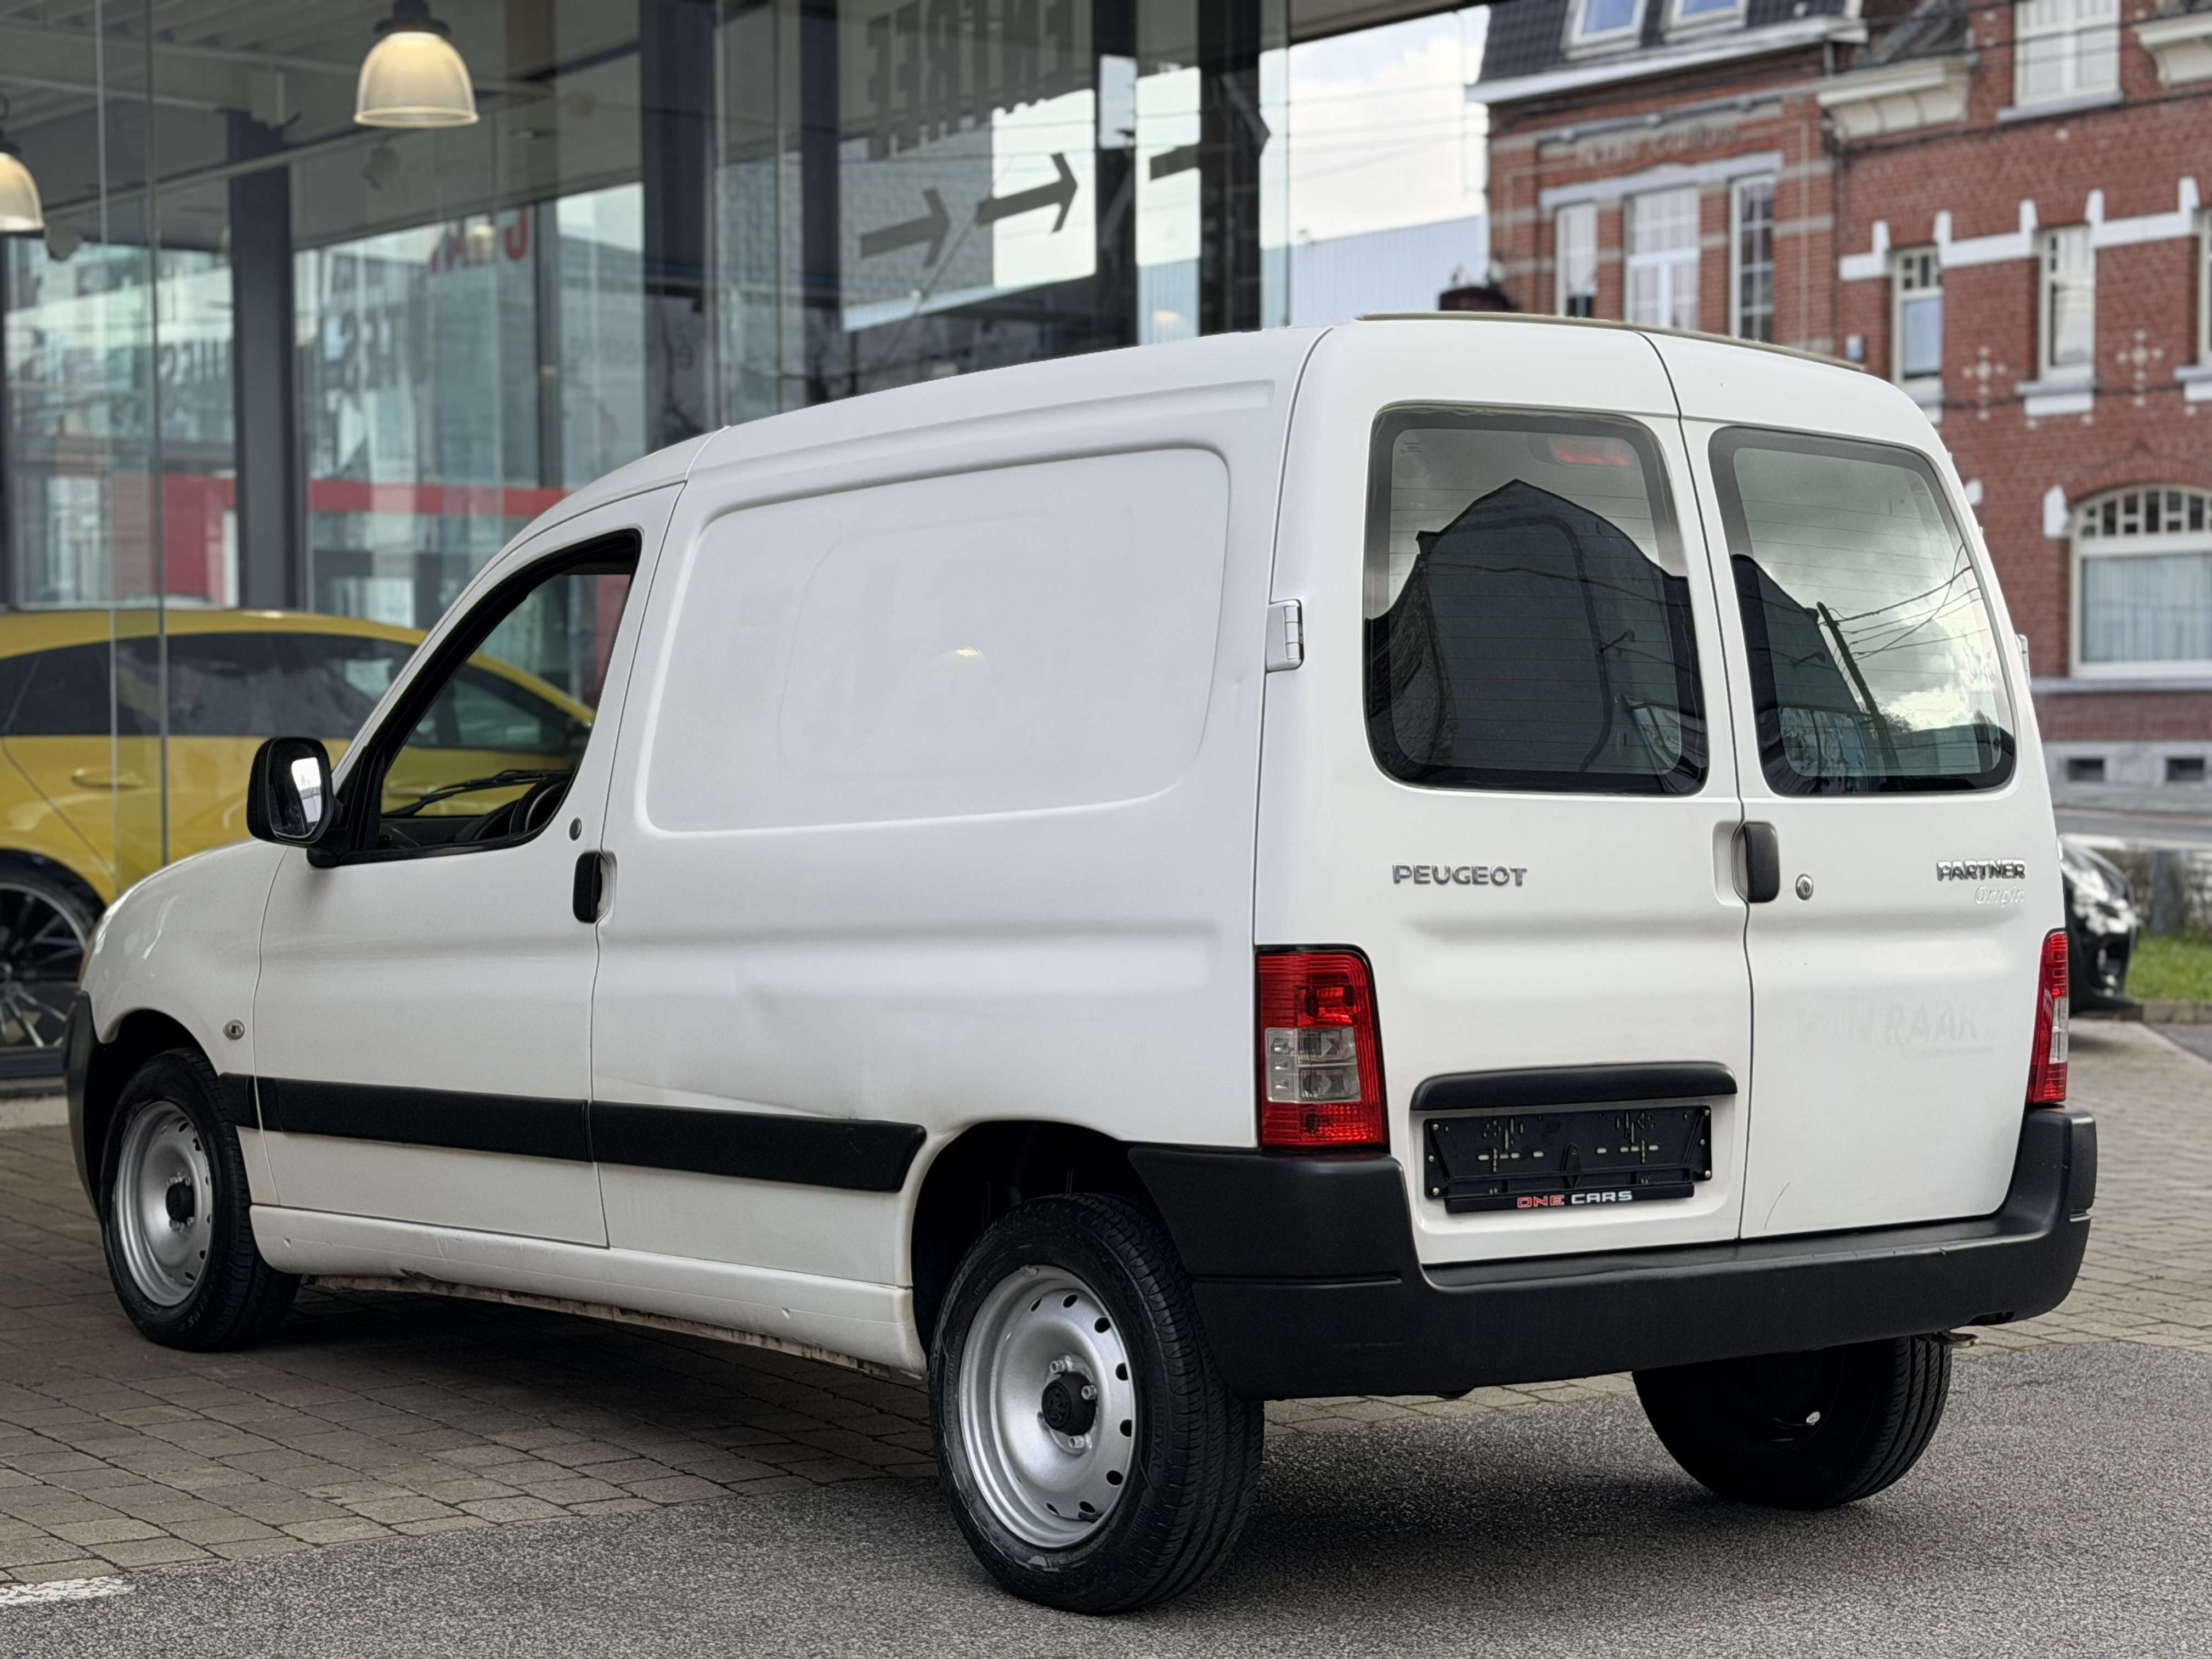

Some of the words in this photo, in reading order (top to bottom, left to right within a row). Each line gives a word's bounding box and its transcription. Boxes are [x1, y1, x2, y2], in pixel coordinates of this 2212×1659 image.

[1392, 864, 1527, 887] PEUGEOT
[1936, 859, 2026, 881] PARTNER
[1974, 884, 2025, 907] Origin
[1517, 1194, 1565, 1208] ONE
[1571, 1190, 1633, 1204] CARS
